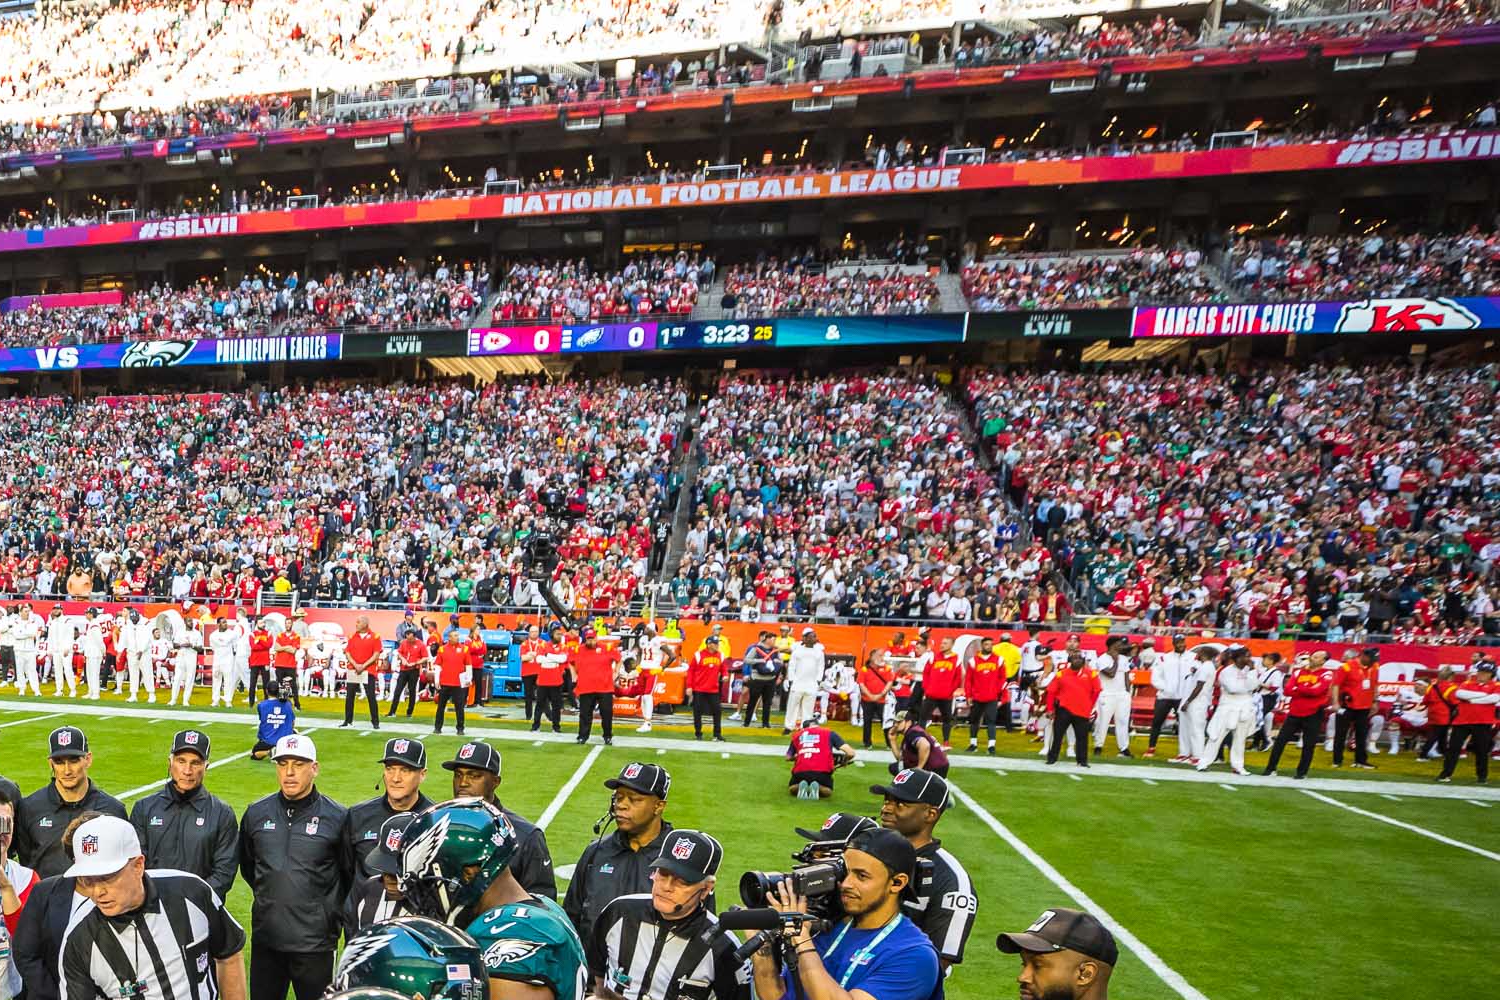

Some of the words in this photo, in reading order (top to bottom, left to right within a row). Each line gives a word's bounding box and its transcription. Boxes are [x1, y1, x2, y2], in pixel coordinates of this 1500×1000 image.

[503, 187, 653, 214] NATIONAL
[660, 176, 821, 205] FOOTBALL
[829, 166, 961, 195] LEAGUE
[139, 216, 238, 240] #SBLVII
[1024, 321, 1072, 336] LVII
[1153, 306, 1218, 336] KANSAS
[1219, 306, 1259, 334] CITY
[1259, 303, 1317, 332] CHIEFS
[534, 330, 551, 351] 0
[628, 327, 645, 348] 0
[661, 327, 686, 345] 1ST
[703, 325, 750, 344] 3:23
[753, 325, 773, 340] 25
[36, 347, 79, 369] VS
[216, 337, 287, 363] PHILADELPHIA
[290, 335, 327, 360] EAGLES
[386, 341, 422, 355] LVII
[946, 894, 975, 912] 103
